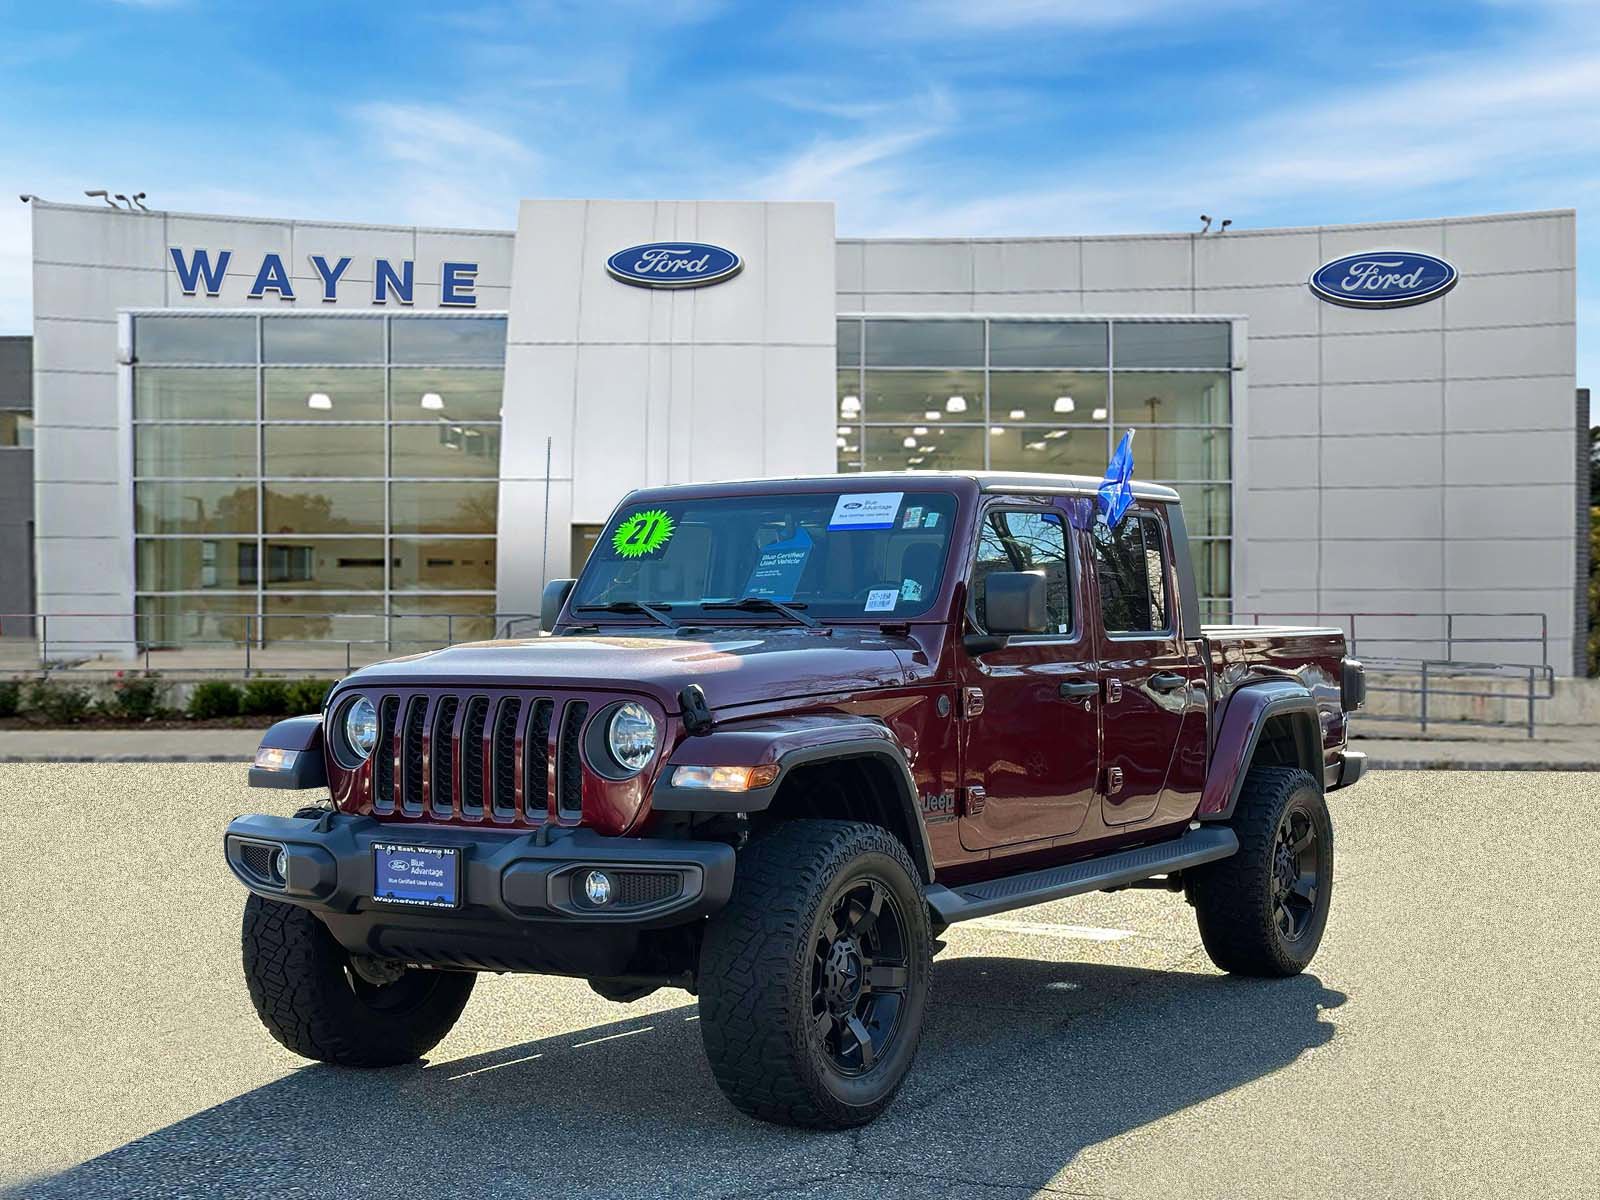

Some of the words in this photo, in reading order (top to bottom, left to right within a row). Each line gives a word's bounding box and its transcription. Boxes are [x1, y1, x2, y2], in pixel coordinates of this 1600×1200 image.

[633, 248, 711, 273] Ford
[169, 248, 479, 307] WAYNE
[1340, 261, 1425, 291] Ford
[625, 519, 660, 545] 21
[920, 791, 955, 813] Jeep
[418, 847, 442, 855] Wayne
[410, 859, 424, 867] Blue
[410, 867, 444, 877] Advantage
[373, 896, 455, 908] Wayneford1.com
